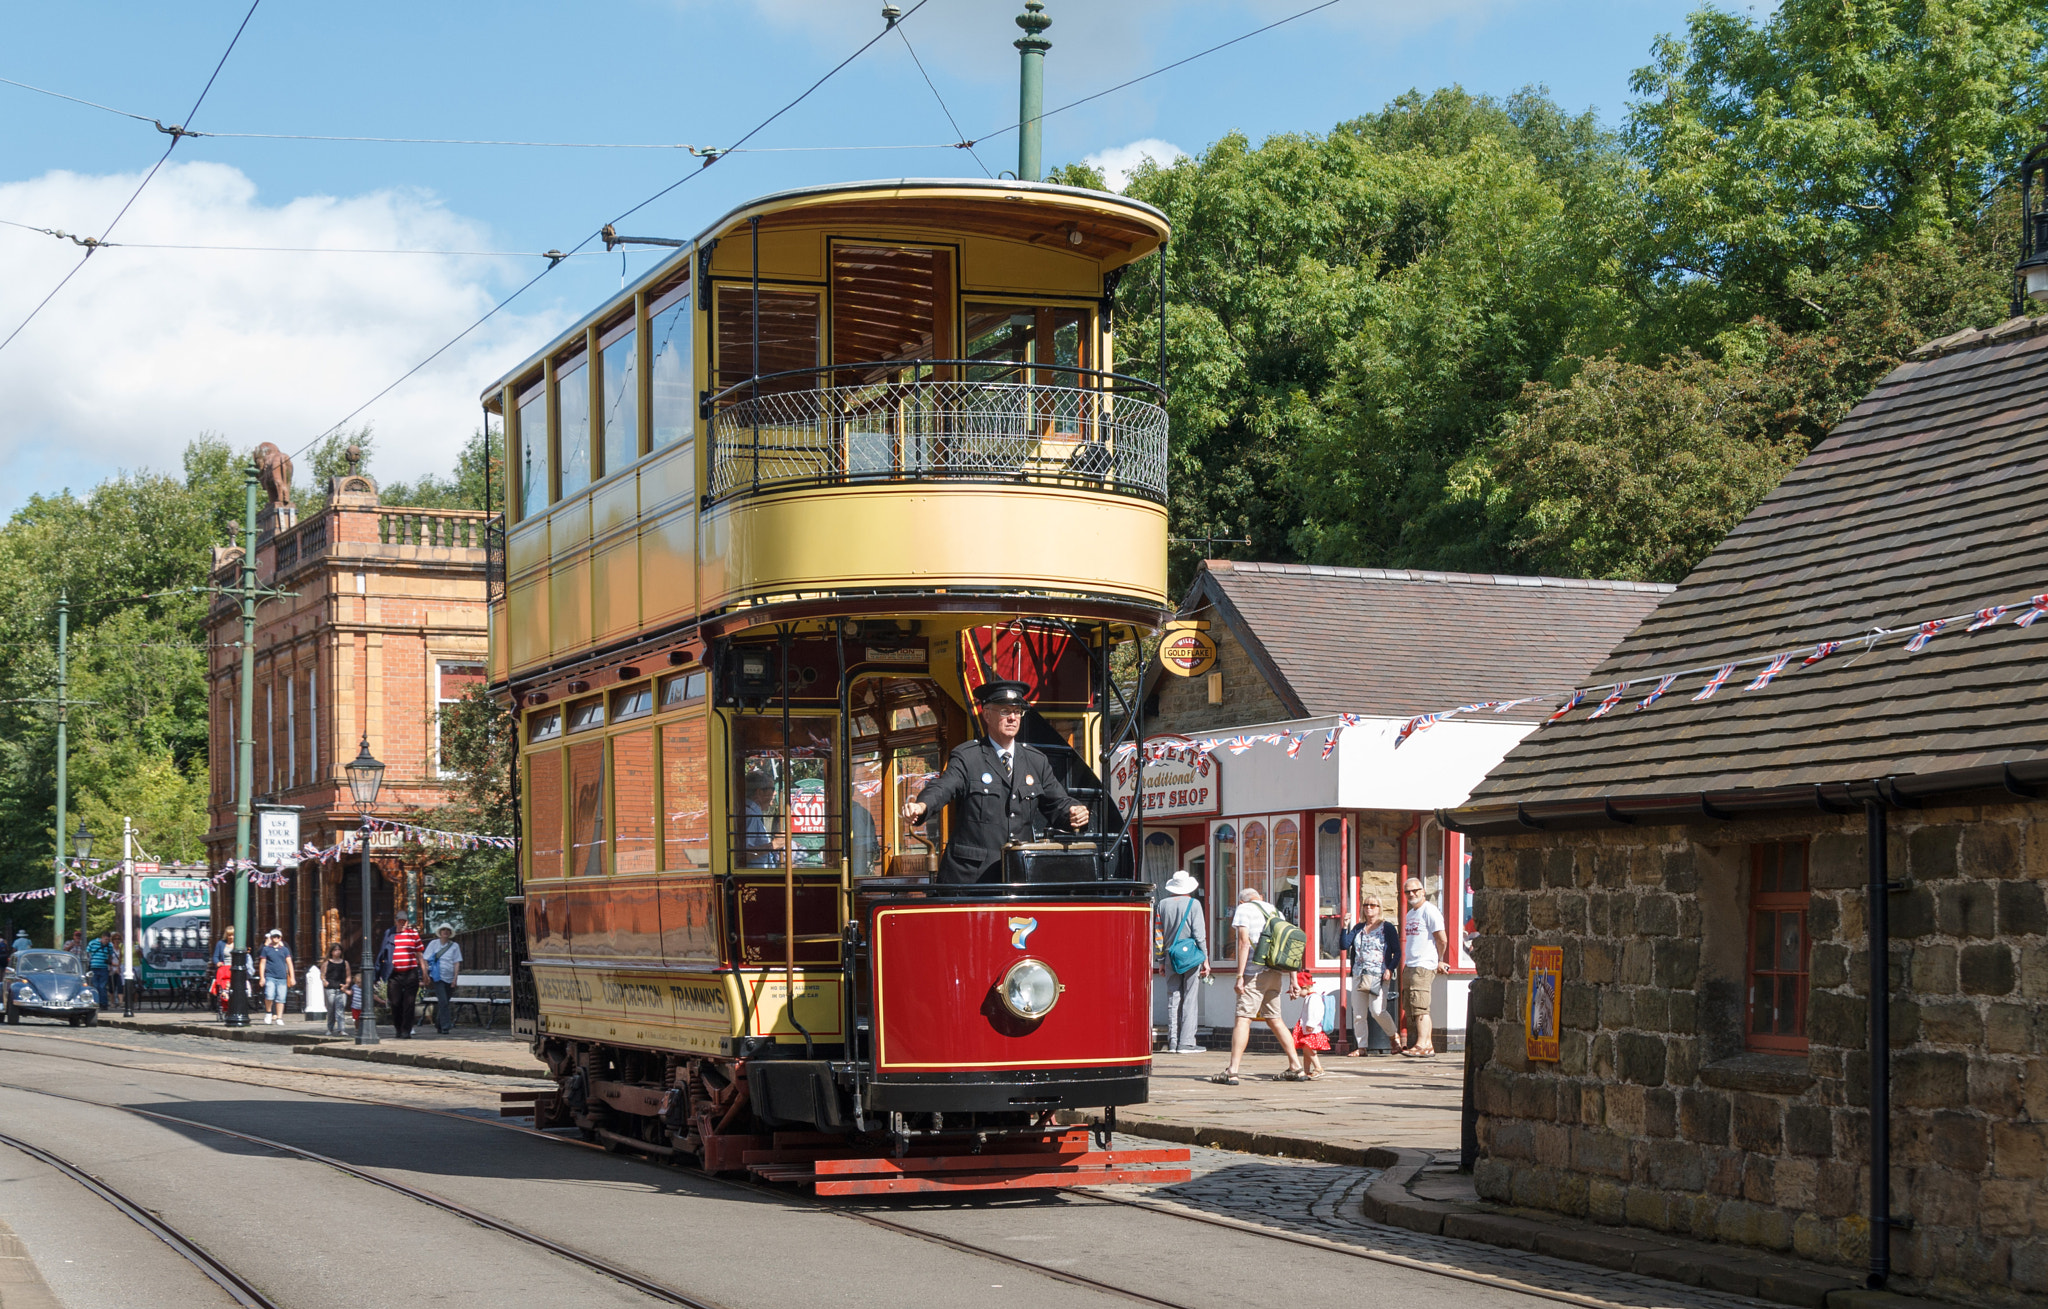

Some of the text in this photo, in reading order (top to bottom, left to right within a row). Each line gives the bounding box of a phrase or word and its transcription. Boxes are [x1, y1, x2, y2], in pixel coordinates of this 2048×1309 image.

[1116, 742, 1210, 790] BARNETTS
[1169, 787, 1208, 808] SHOP
[794, 803, 825, 826] STO
[1008, 916, 1038, 949] 7
[537, 978, 725, 1014] CHESTERFIELD CORPORATION TRAMWAYS
